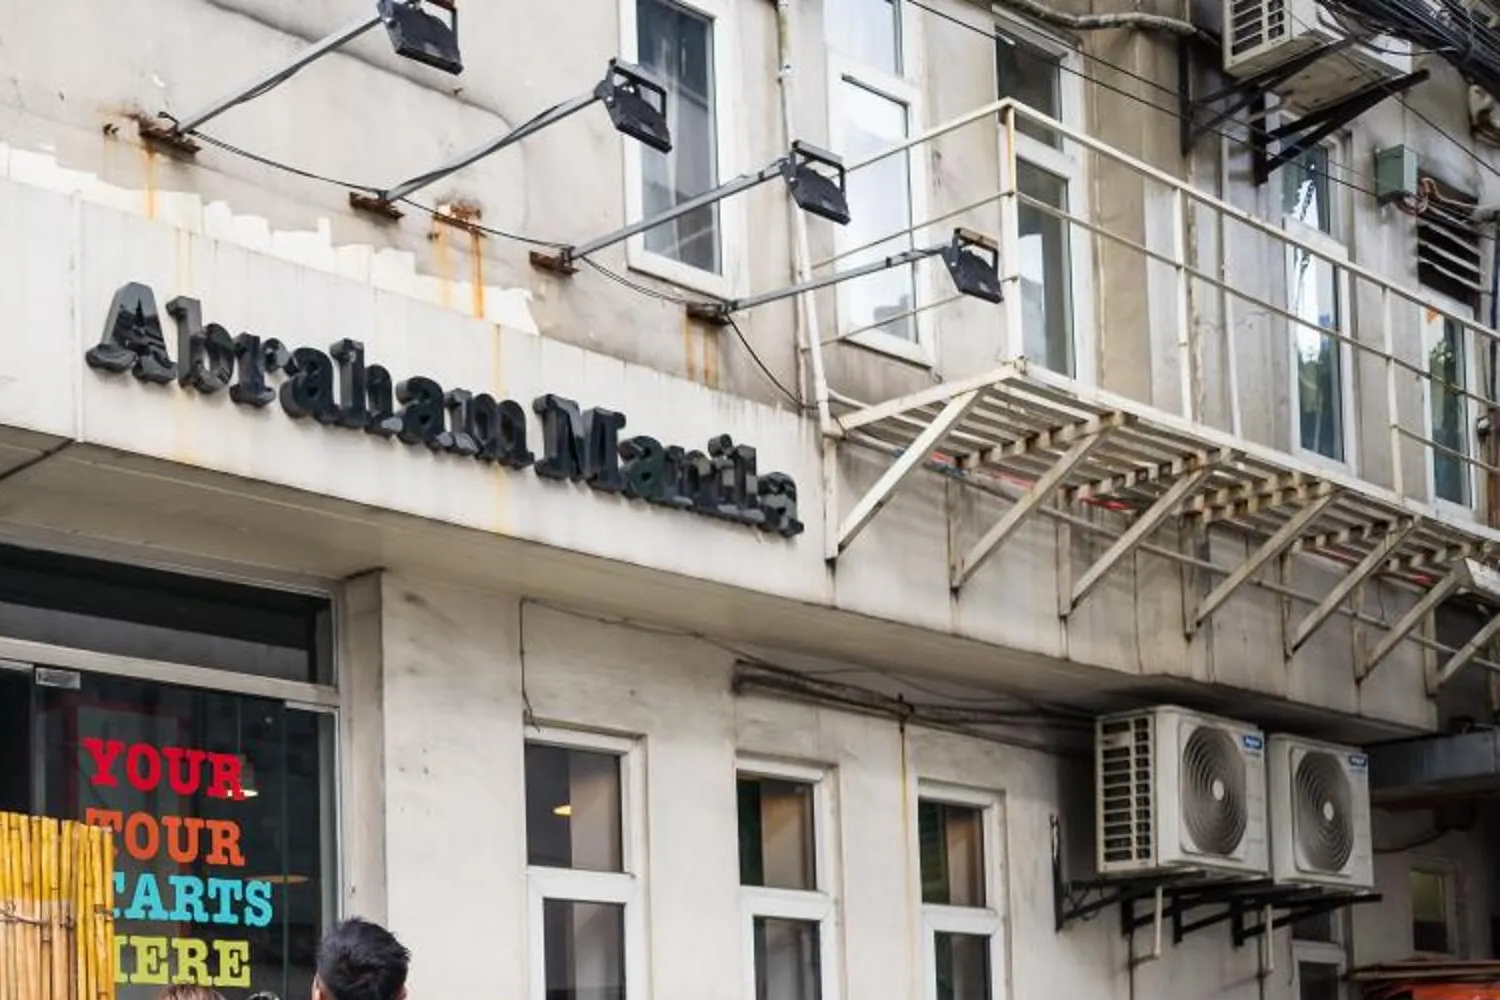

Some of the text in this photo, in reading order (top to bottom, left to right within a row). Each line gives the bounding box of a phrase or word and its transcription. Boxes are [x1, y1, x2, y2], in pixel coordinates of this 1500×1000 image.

[85, 281, 804, 537] Abraham Manila
[84, 738, 245, 800] YOUR
[112, 871, 273, 926] ARTS
